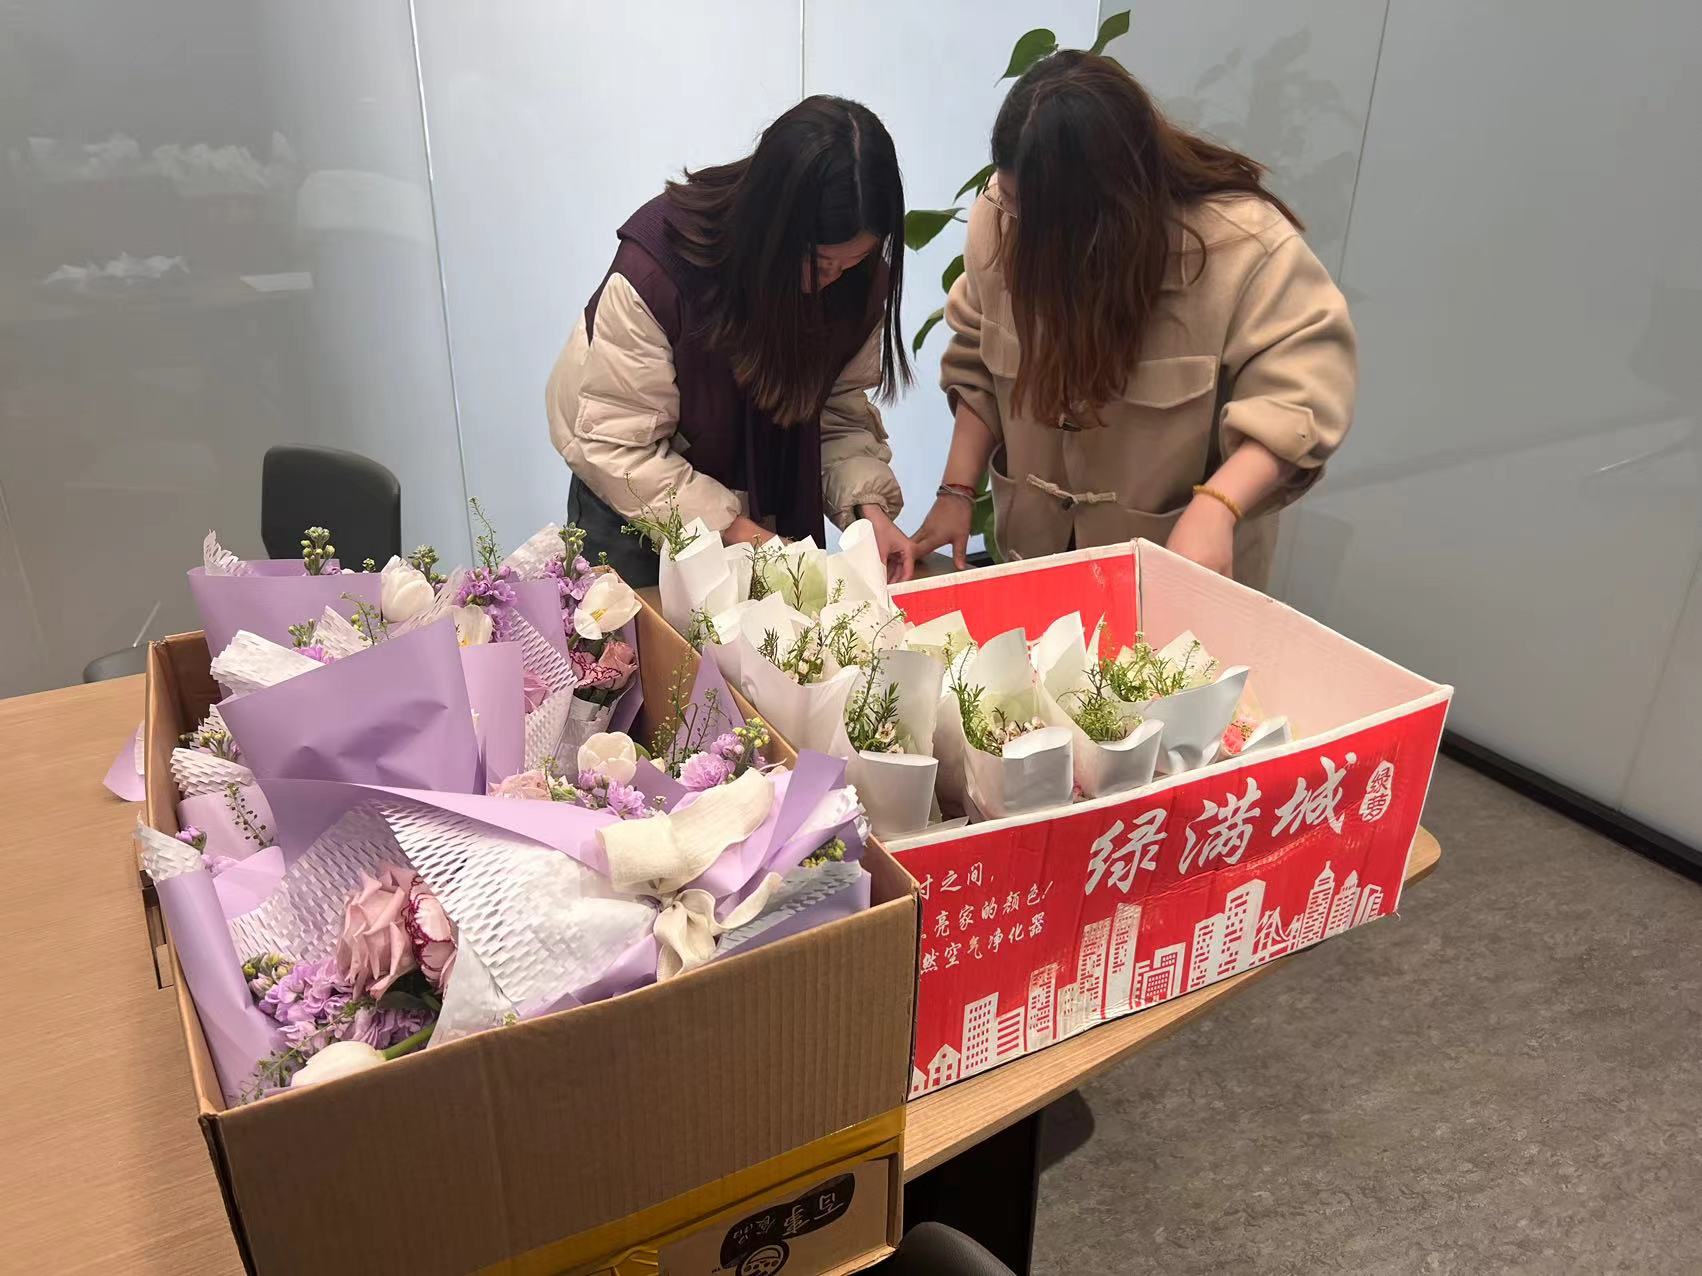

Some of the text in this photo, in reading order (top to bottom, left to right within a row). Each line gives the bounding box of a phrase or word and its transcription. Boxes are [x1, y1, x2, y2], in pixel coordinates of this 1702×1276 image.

[1085, 751, 1357, 895] 绿满城
[1361, 766, 1391, 822] 绿萝
[920, 881, 1053, 939] 亮家的颜色!
[920, 911, 1045, 975] 然空气净化器
